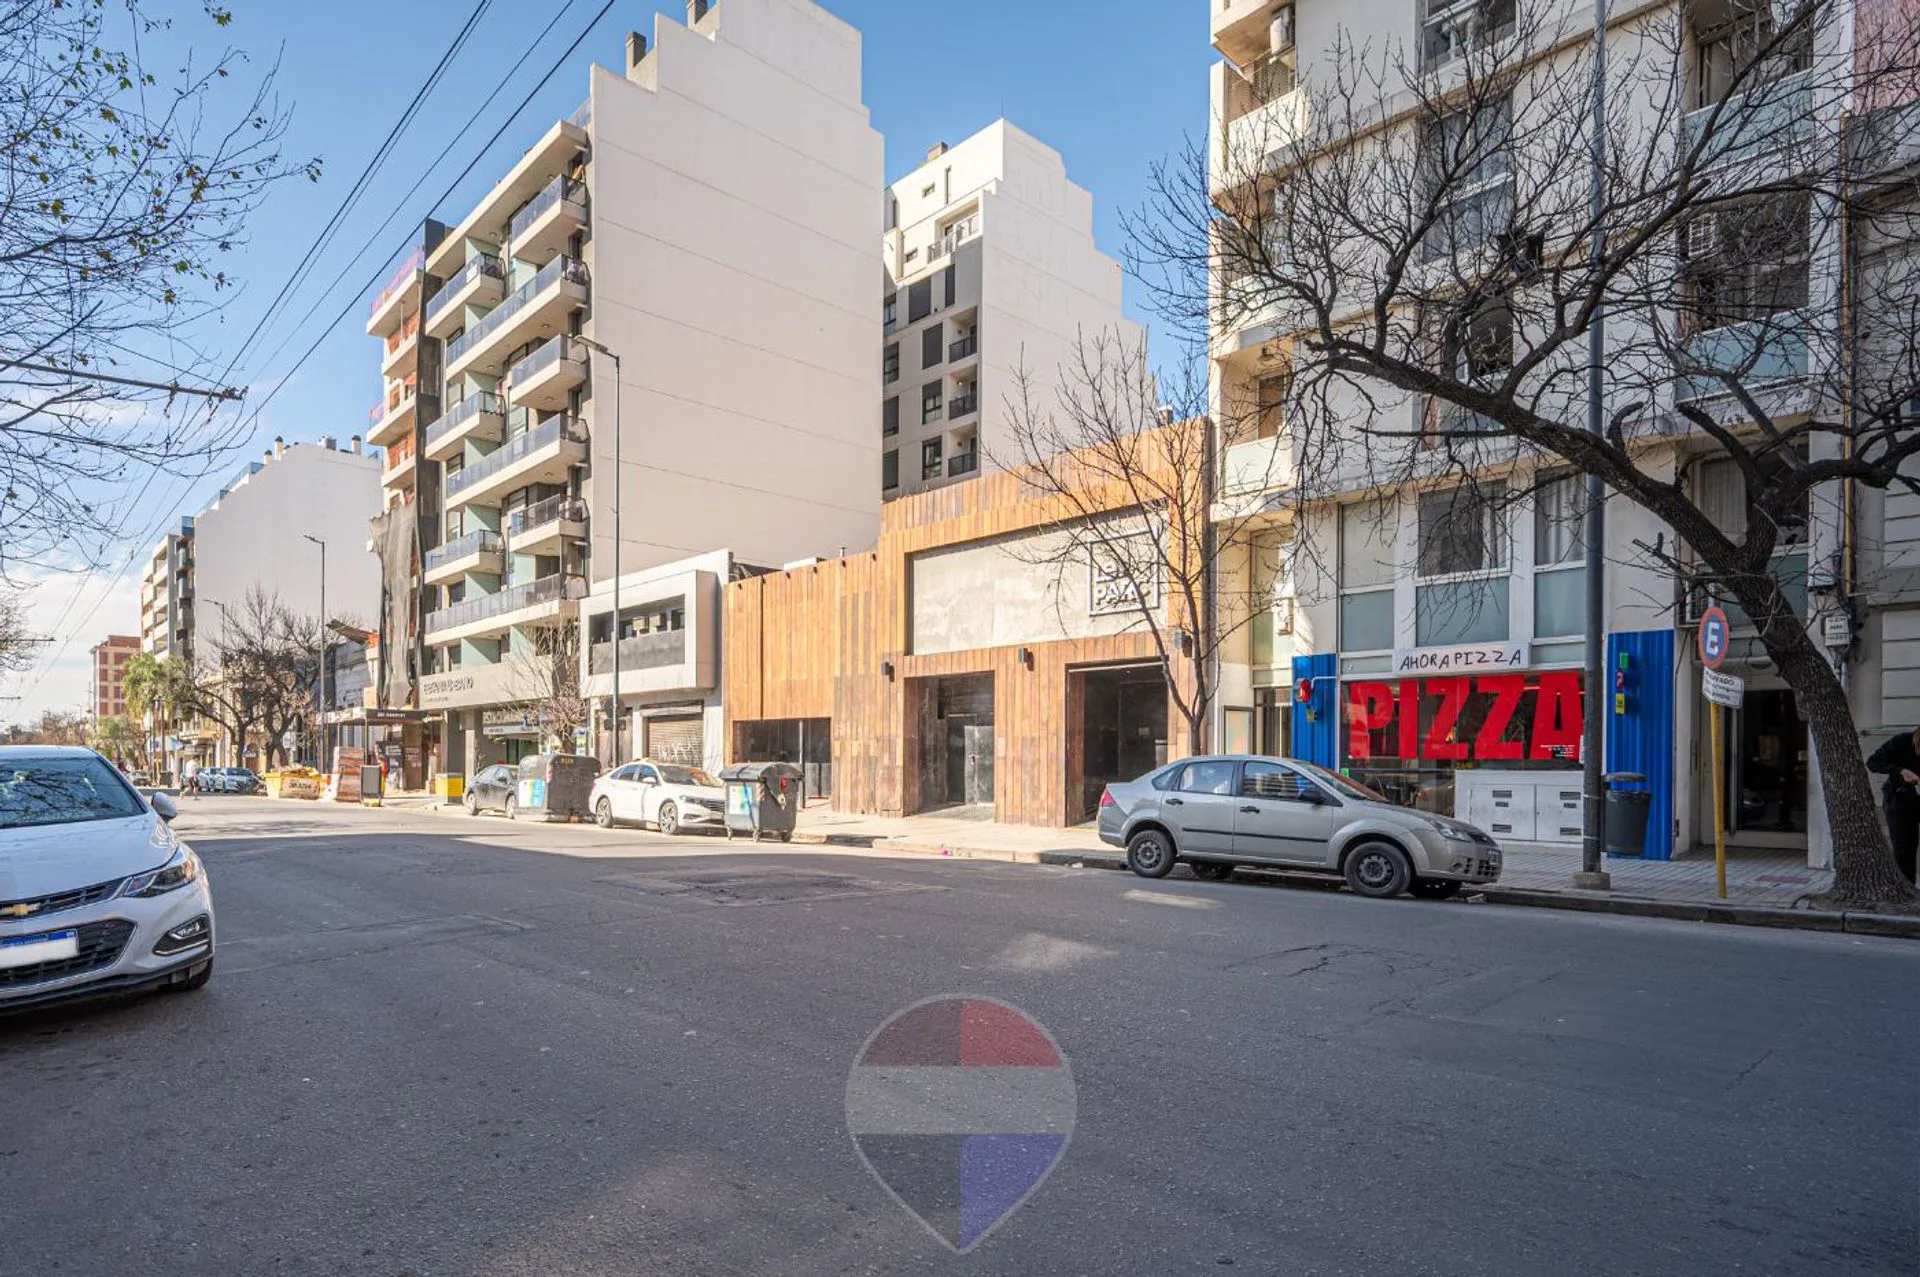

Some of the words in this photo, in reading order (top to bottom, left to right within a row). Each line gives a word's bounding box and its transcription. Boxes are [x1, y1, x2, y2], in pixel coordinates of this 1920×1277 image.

[1706, 621, 1720, 656] E
[1400, 653, 1450, 670] AHORA
[1454, 649, 1522, 666] PIZZA
[1349, 671, 1585, 760] PIZZA
